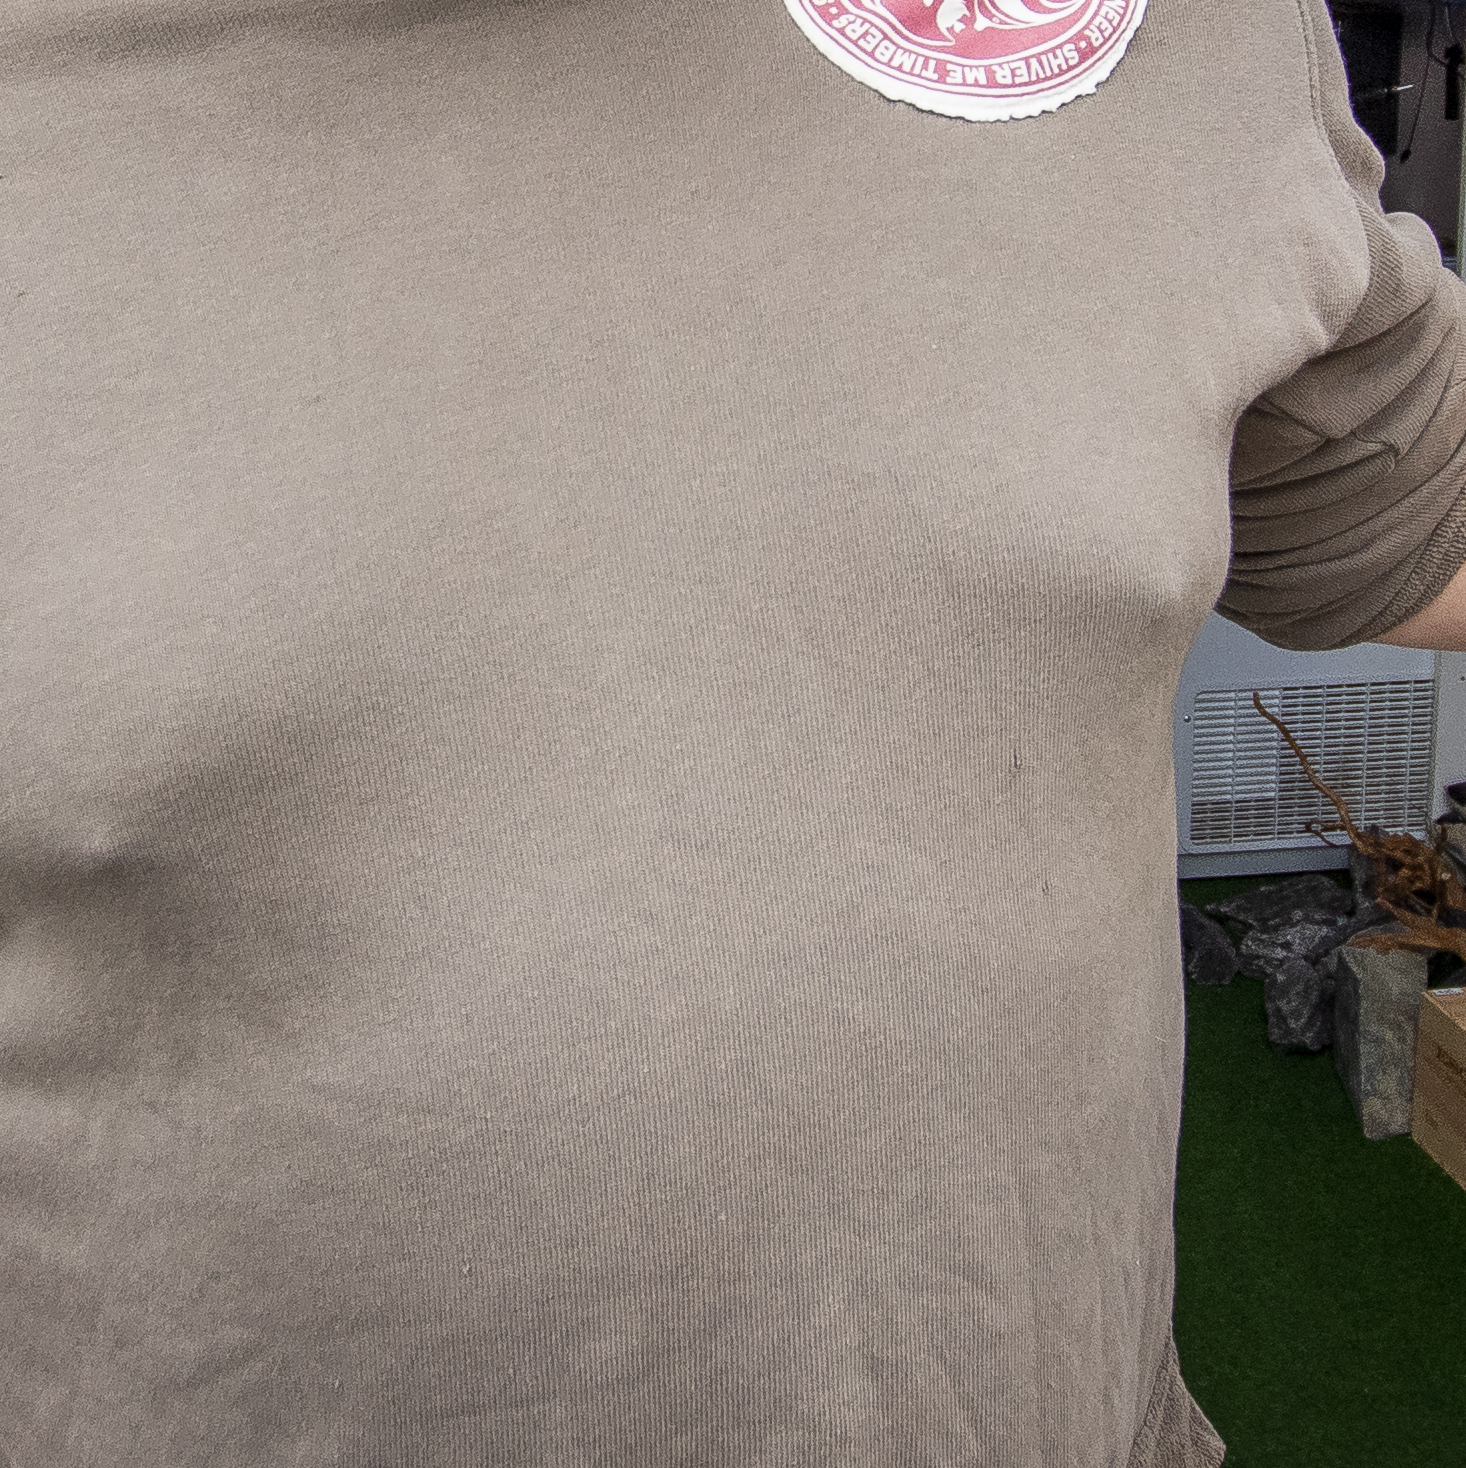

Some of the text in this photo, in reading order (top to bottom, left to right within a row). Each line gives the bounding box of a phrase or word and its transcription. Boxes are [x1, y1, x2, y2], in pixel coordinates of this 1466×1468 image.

[833, 12, 1081, 87] SHIVER ME TIMBERS
